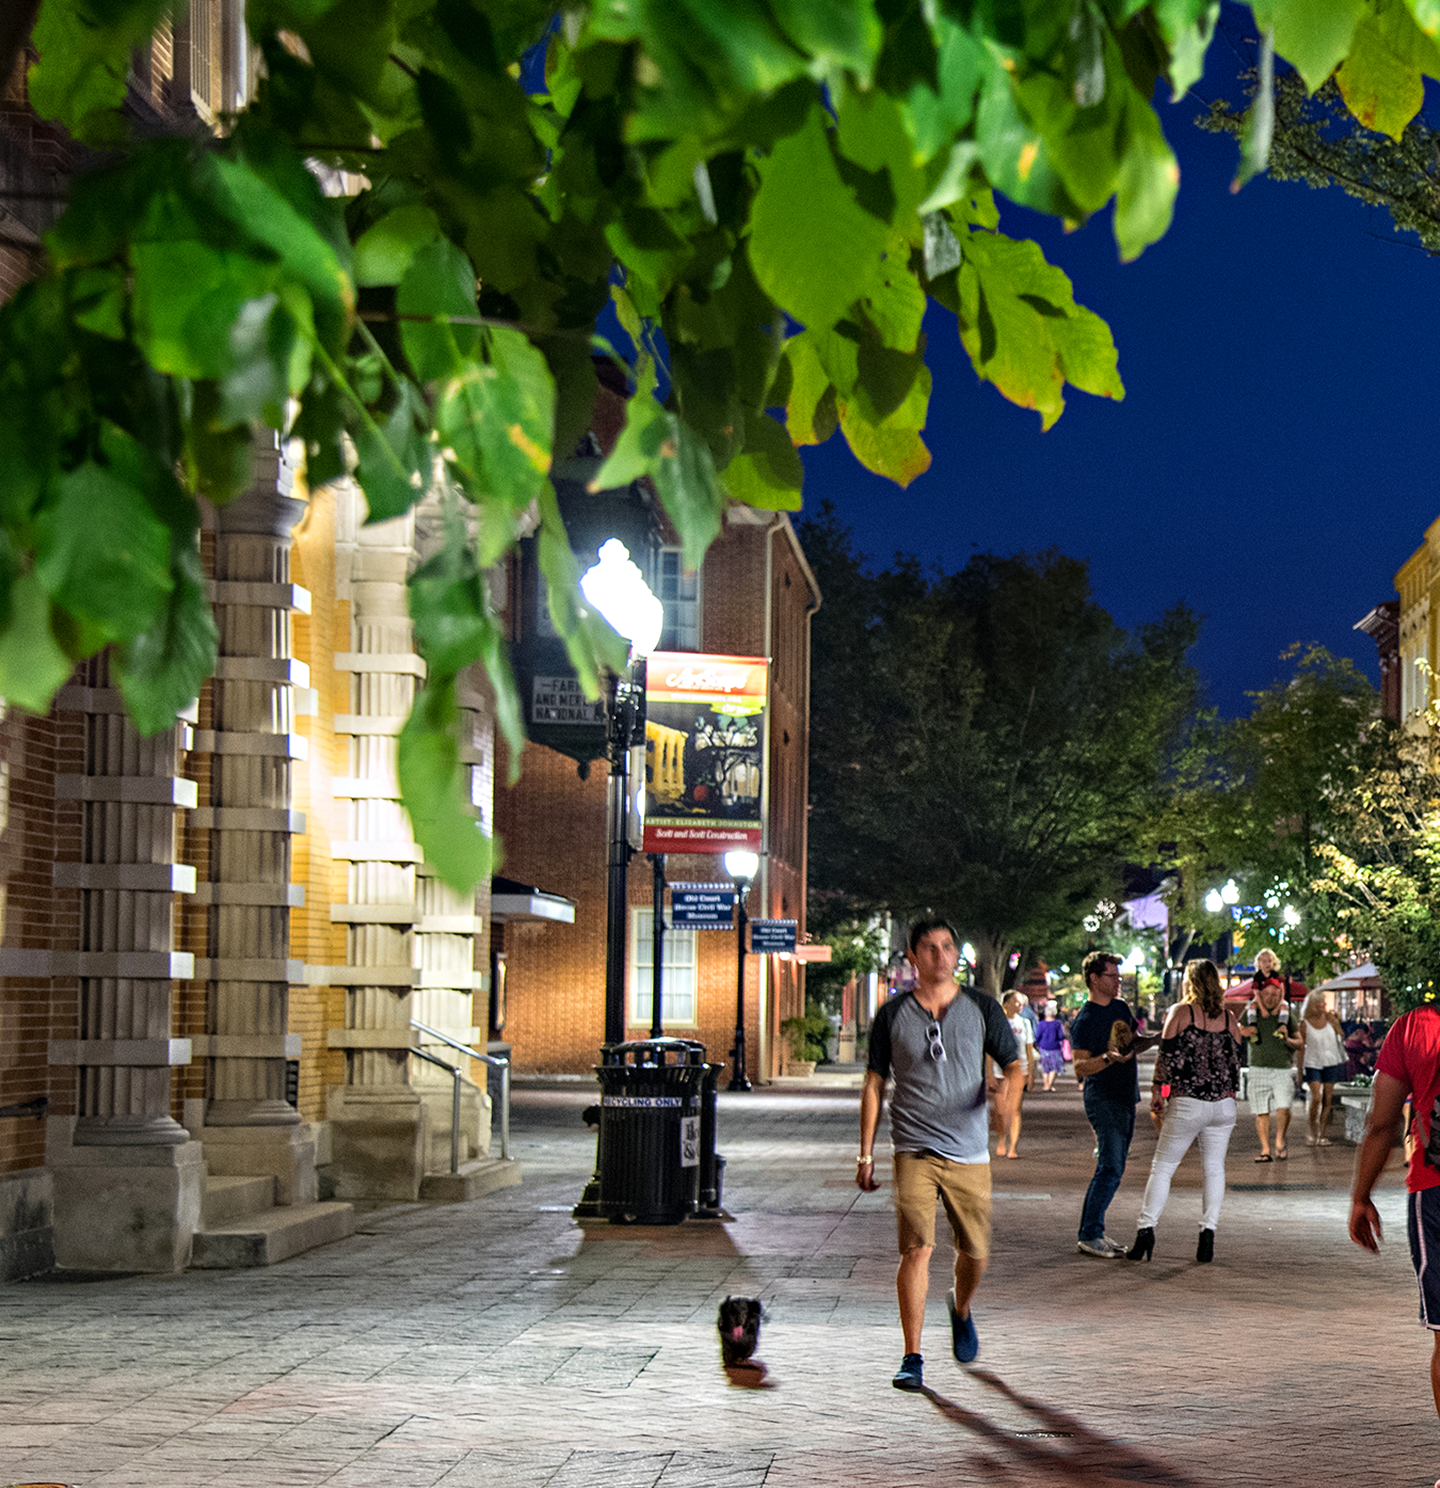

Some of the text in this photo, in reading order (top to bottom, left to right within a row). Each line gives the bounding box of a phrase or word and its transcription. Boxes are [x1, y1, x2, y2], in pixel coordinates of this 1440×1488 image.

[535, 694, 557, 705] AND
[535, 707, 590, 721] NATIONAL
[656, 828, 748, 840] Scott and Scott Construction
[699, 894, 721, 902] Court
[655, 1097, 682, 1108] ONLY
